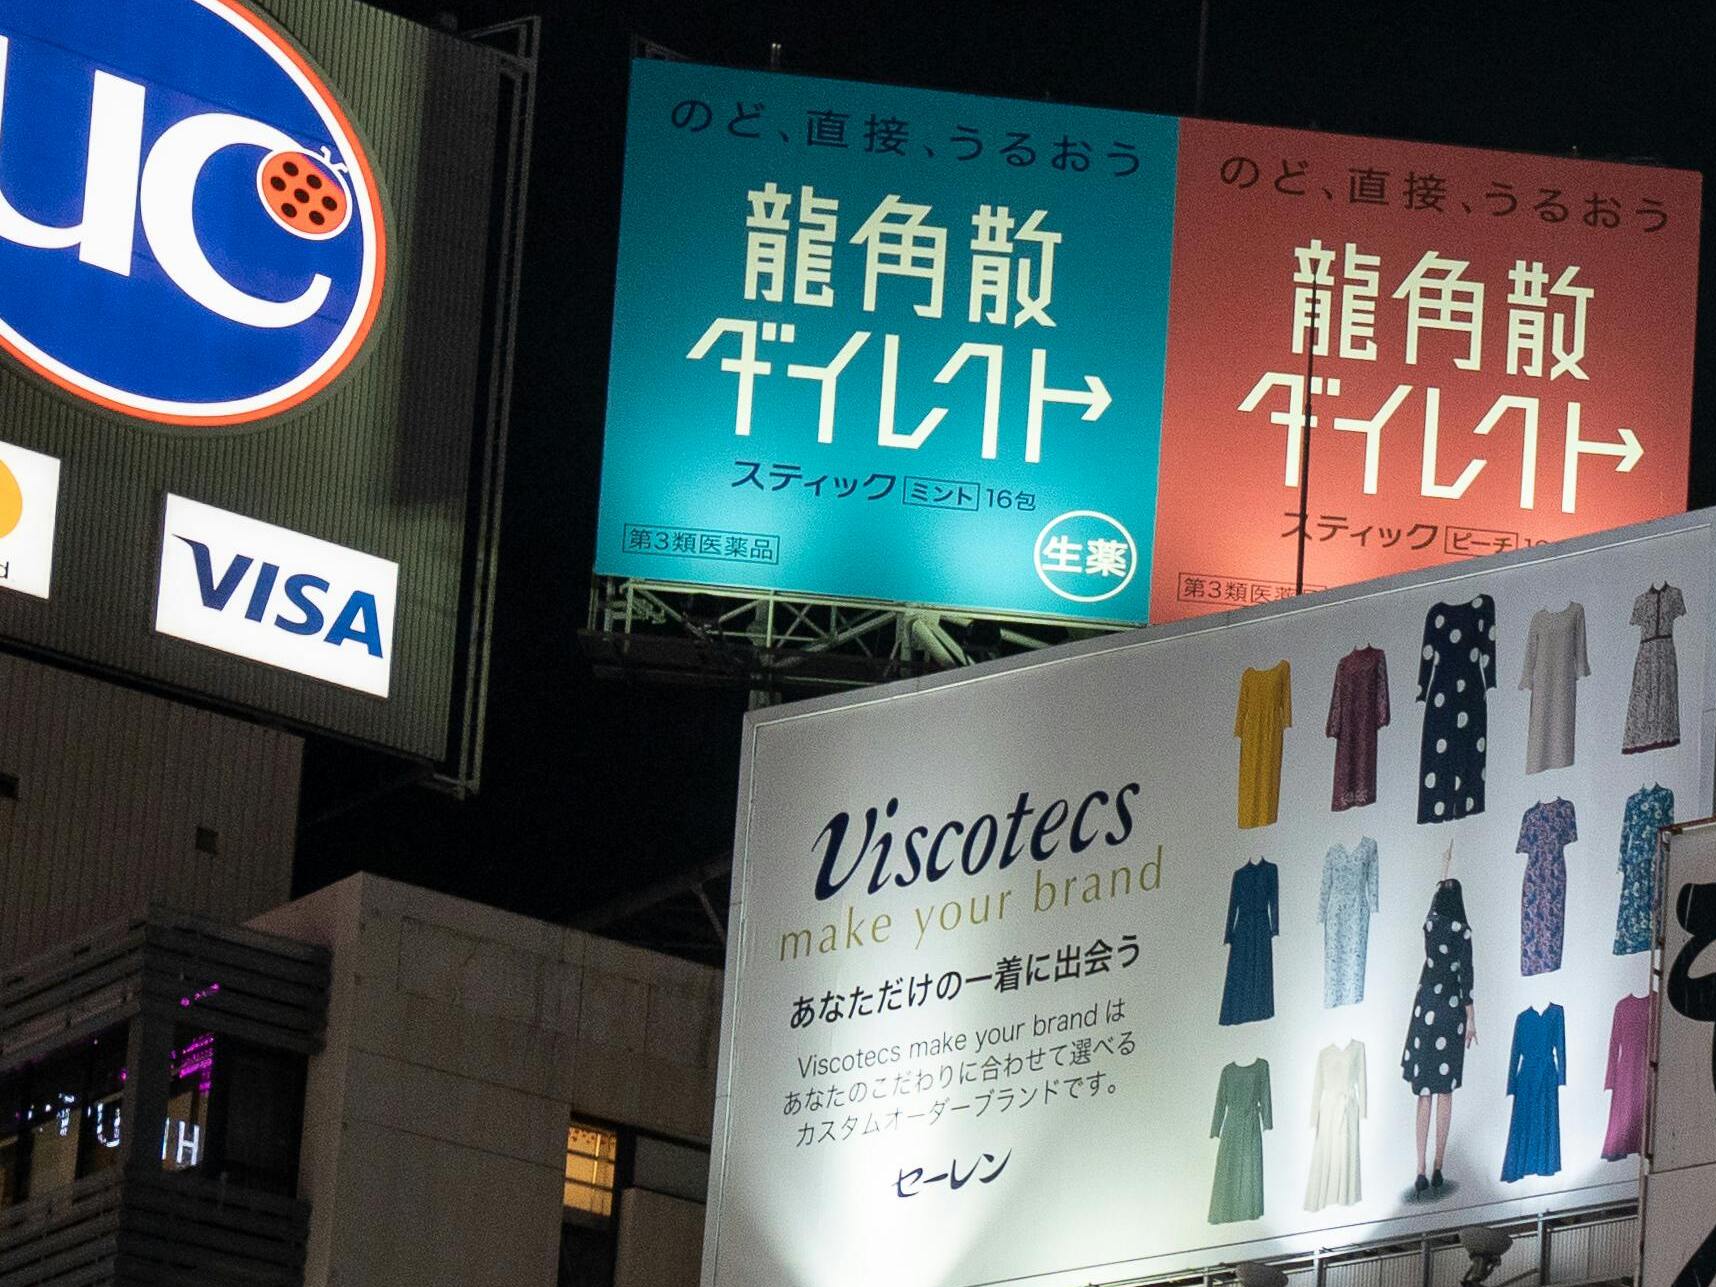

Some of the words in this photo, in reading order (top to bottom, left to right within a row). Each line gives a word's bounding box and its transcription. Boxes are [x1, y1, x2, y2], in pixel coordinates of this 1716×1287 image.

[670, 98, 1141, 177] のど、直接、うるおう
[1221, 155, 1669, 233] のど、直接、うるおう
[744, 183, 1063, 329] 龍角散
[1291, 240, 1595, 381] 龍角散
[687, 317, 1112, 463] ダイレクト
[1238, 372, 1644, 513] ダイレクト
[172, 533, 384, 659] VISA
[1042, 535, 1129, 578] 生薬
[811, 782, 1140, 901] Viscotecs
[779, 907, 892, 962] make
[914, 889, 1012, 950] your
[1033, 845, 1164, 914] brand
[789, 934, 1141, 1030] あなただけの一着に出会う
[797, 1040, 901, 1078] Viscotecs
[908, 1030, 967, 1060] make
[974, 1022, 1026, 1052] your
[1033, 1003, 1098, 1038] brand
[892, 1148, 1012, 1198] セーレン
